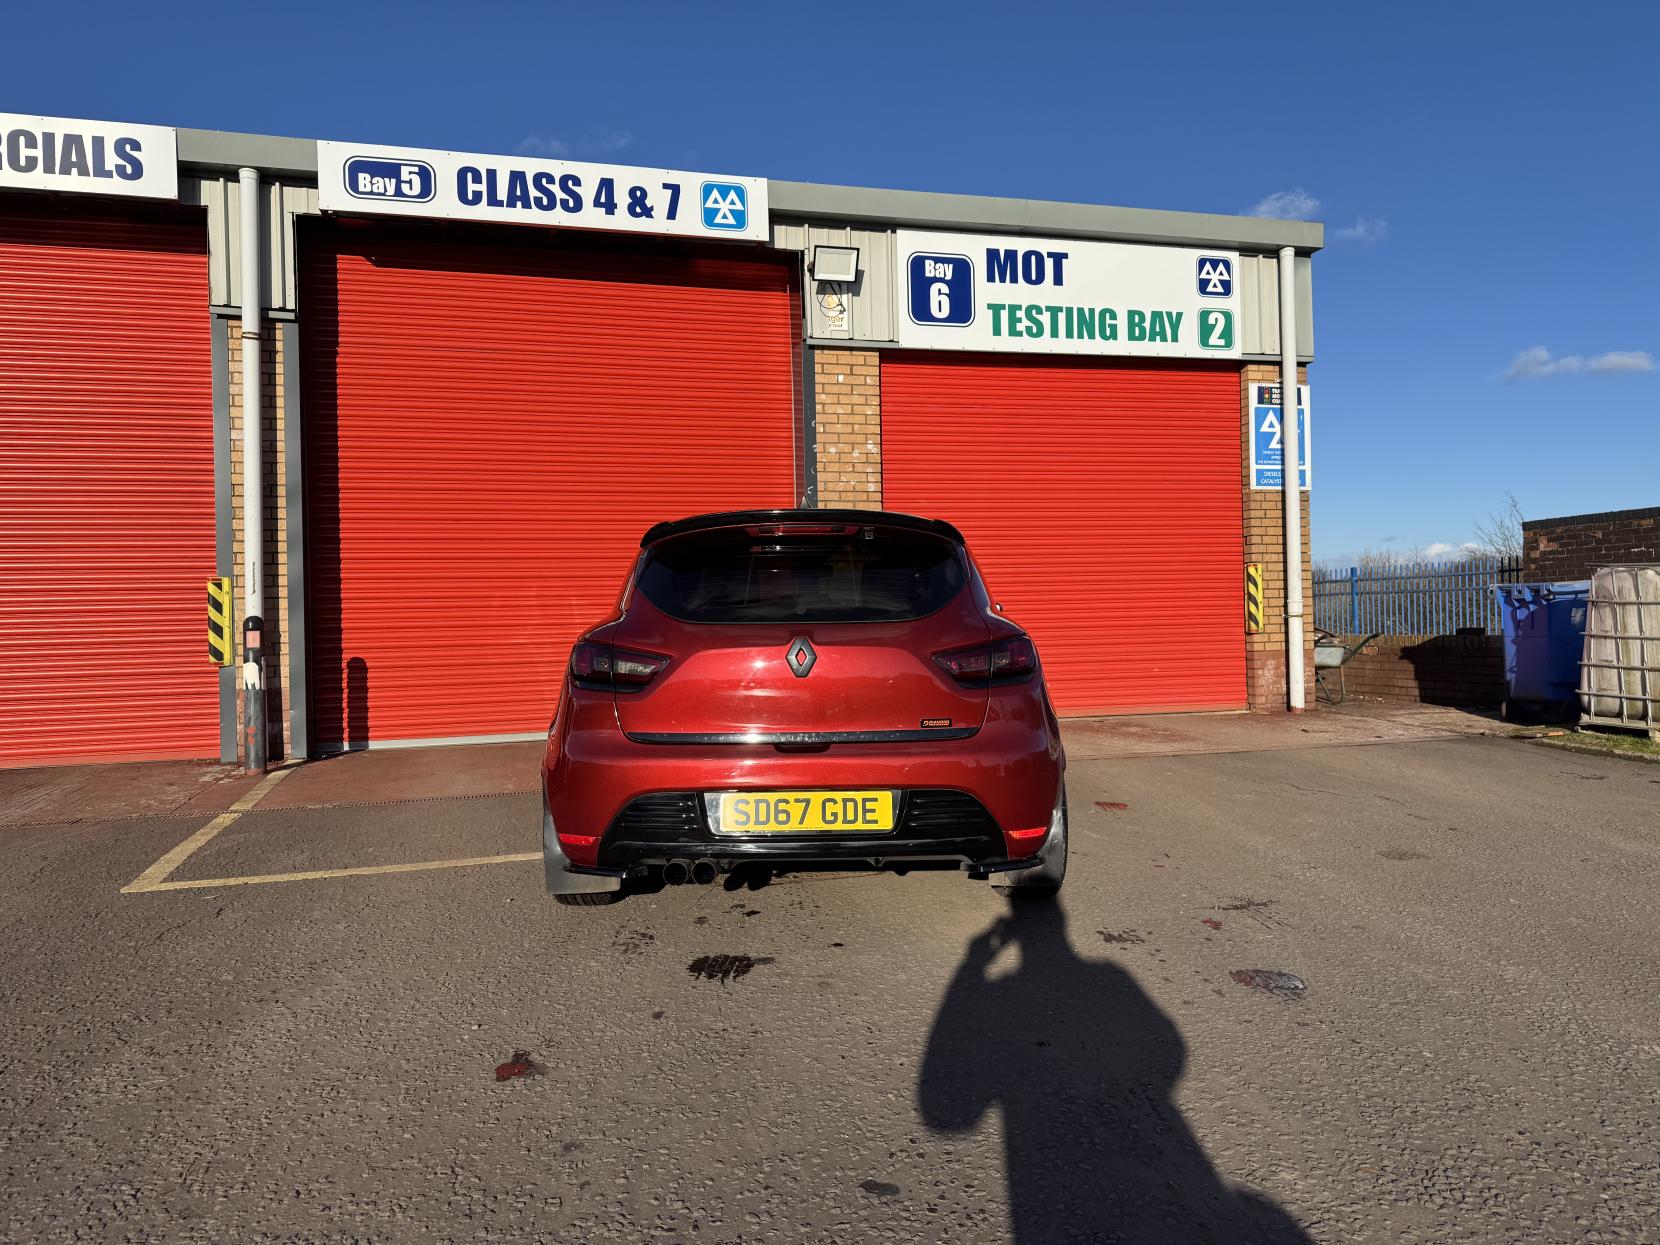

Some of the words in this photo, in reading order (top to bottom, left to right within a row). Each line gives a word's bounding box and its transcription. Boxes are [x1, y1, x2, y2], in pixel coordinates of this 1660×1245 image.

[0, 128, 144, 181] CIALS
[357, 172, 396, 196] Bay
[400, 165, 421, 196] 5
[456, 166, 583, 214] CLASS
[593, 177, 618, 216] 4
[627, 185, 655, 219] &
[662, 182, 681, 221] 7
[924, 259, 953, 280] Bay
[986, 248, 1069, 286] MOT
[929, 282, 951, 319] 6
[987, 303, 1118, 341] TESTING
[1127, 309, 1184, 343] BAY
[1208, 311, 1226, 346] 2
[734, 798, 811, 826] SD67
[821, 797, 879, 825] GDE
